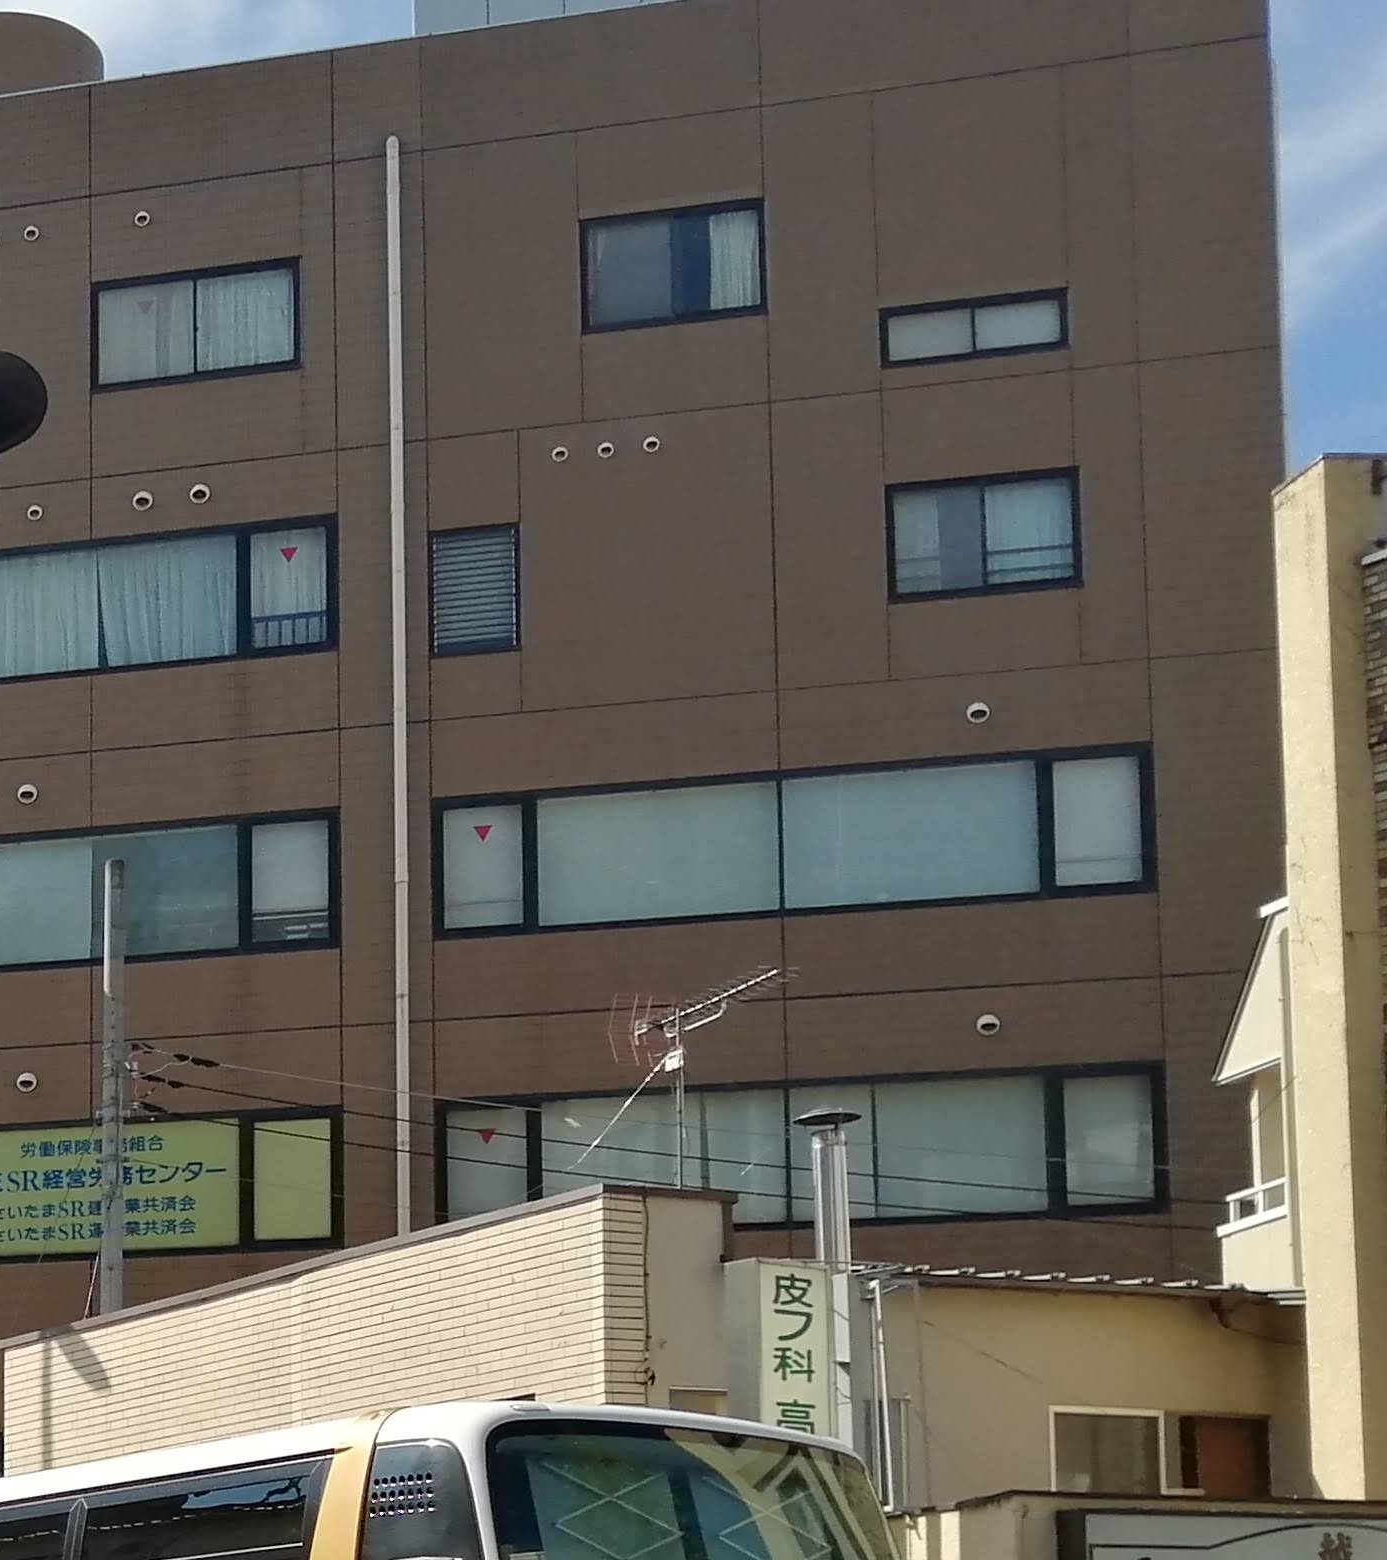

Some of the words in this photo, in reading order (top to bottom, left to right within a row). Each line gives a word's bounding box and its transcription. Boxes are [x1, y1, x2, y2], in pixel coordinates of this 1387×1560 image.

[772, 1273, 816, 1383] 皮フ科
[775, 1399, 817, 1436] 高
